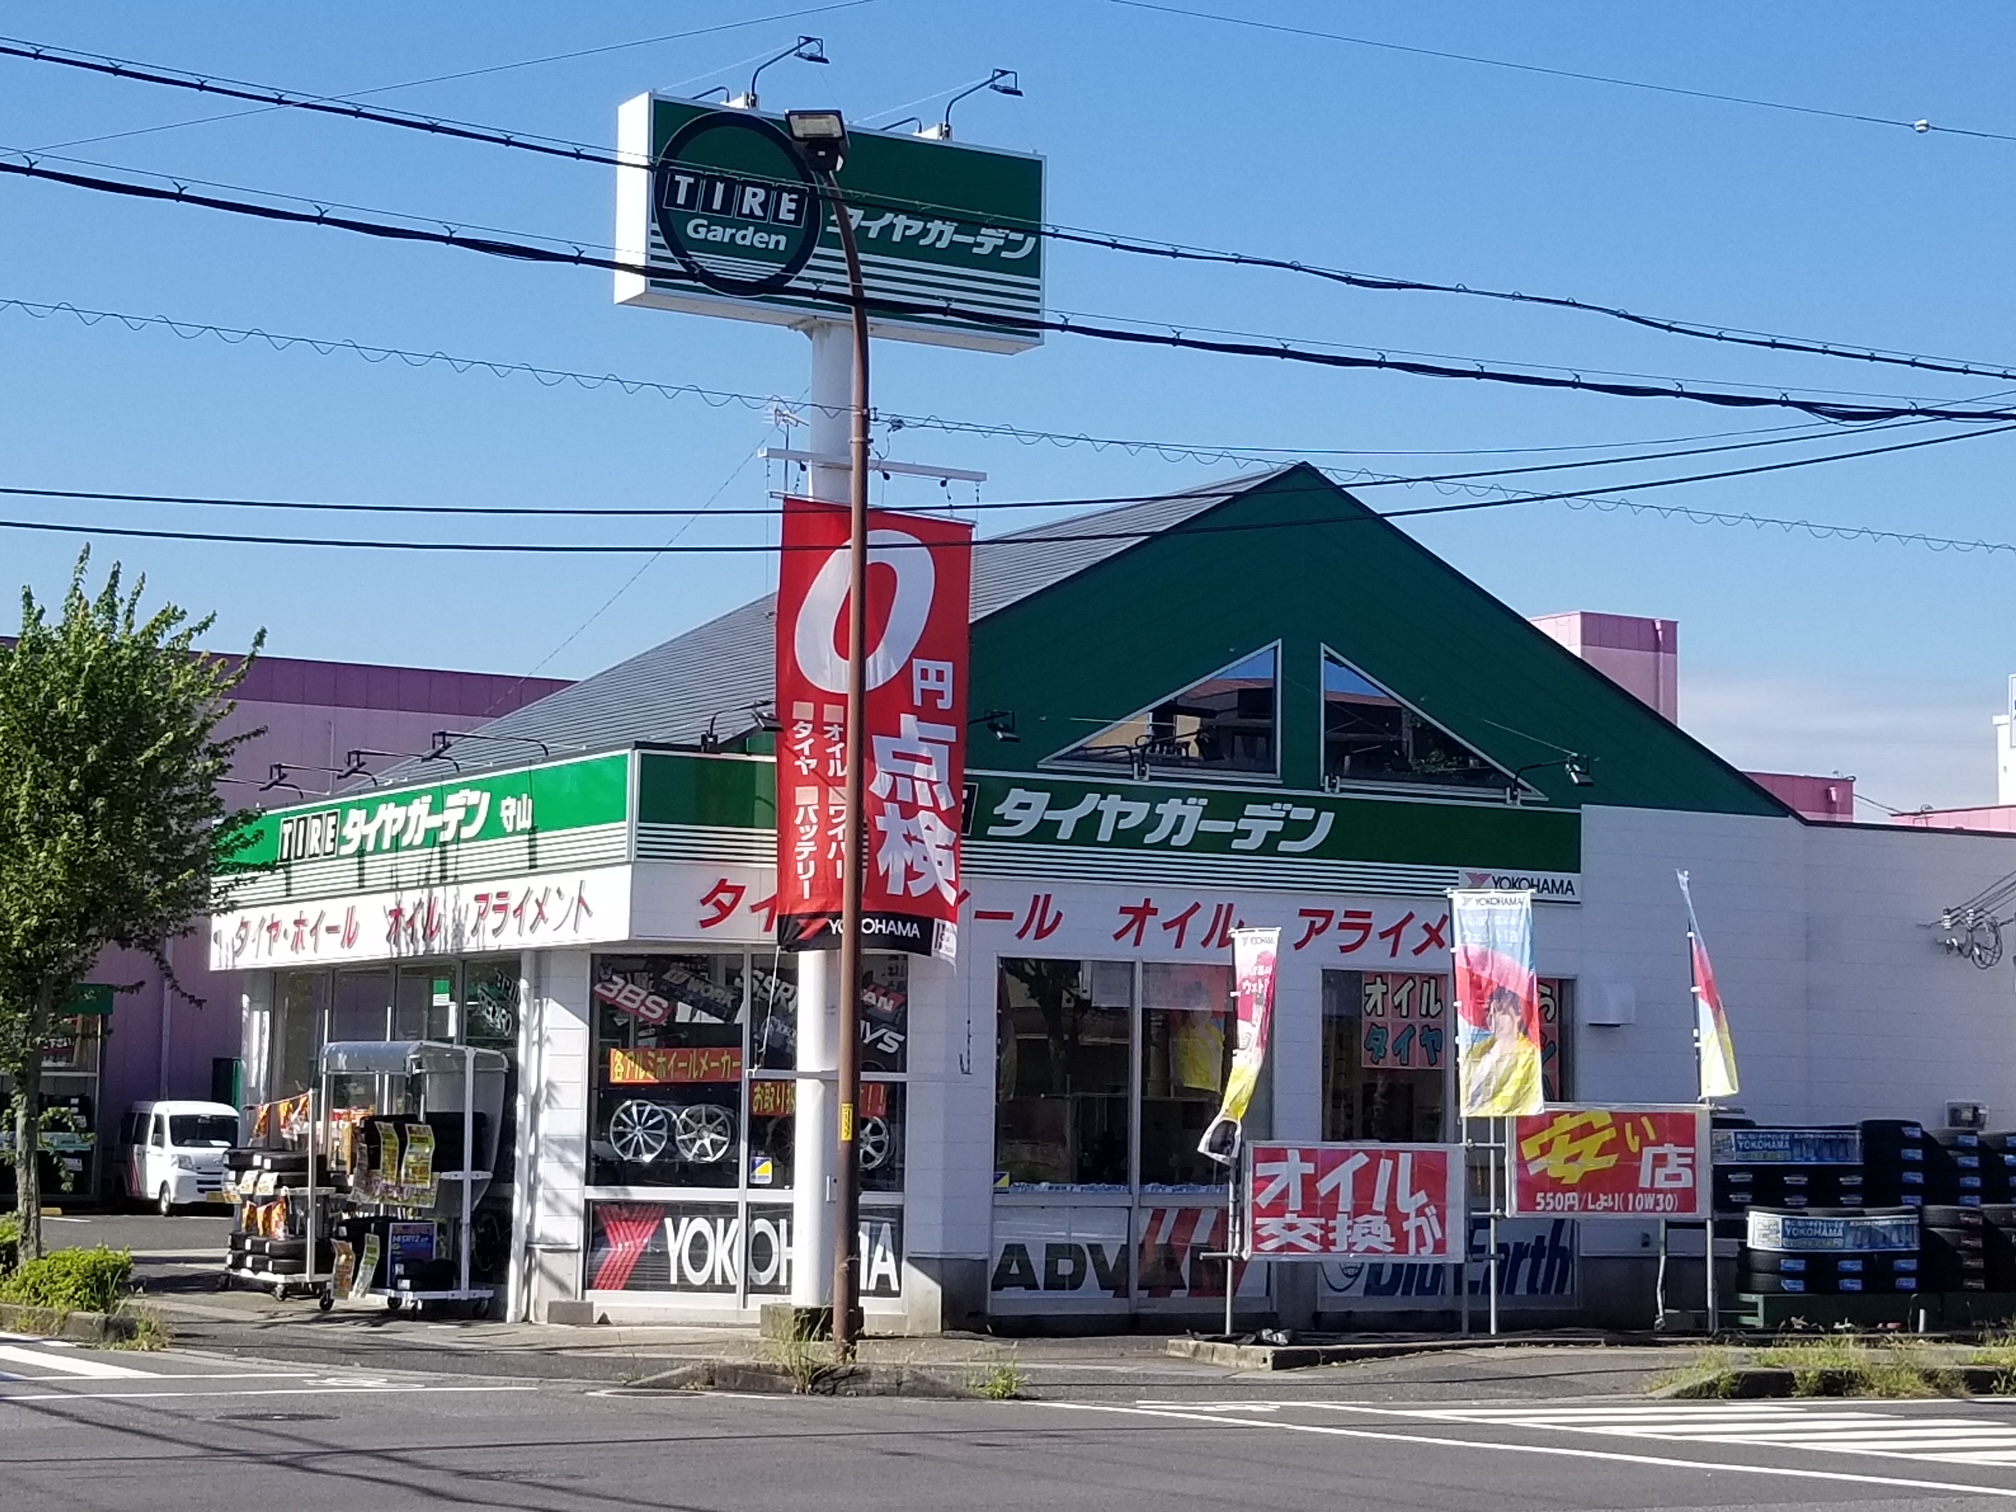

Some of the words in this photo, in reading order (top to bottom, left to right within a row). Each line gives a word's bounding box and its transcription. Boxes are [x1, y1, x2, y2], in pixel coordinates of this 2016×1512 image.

[673, 173, 800, 223] TIRE
[685, 217, 787, 252] Garden
[826, 206, 1037, 260] タイヤガーデン
[792, 720, 818, 776] タイヤ
[823, 722, 848, 777] オイル
[281, 812, 338, 861] TIRE
[340, 788, 491, 856] タイヤガーデン
[500, 794, 533, 833] 守山
[987, 787, 1337, 853] タイヤガーデン
[794, 804, 820, 900] バッテリー
[471, 880, 593, 938] アライメント
[1492, 875, 1576, 897] YOKOHAMA
[828, 916, 921, 939] YOOHAMA
[1112, 896, 1243, 949] オイル
[1364, 975, 1443, 1018] オイル
[1364, 1022, 1443, 1067] タイヤ
[1737, 1139, 1791, 1151] YOKOHAMA
[1256, 1149, 1428, 1214] オイル
[664, 1216, 900, 1291] YOKOHA
[1255, 1204, 1443, 1256] 交換が
[1785, 1226, 1844, 1239] YOKOHAMA
